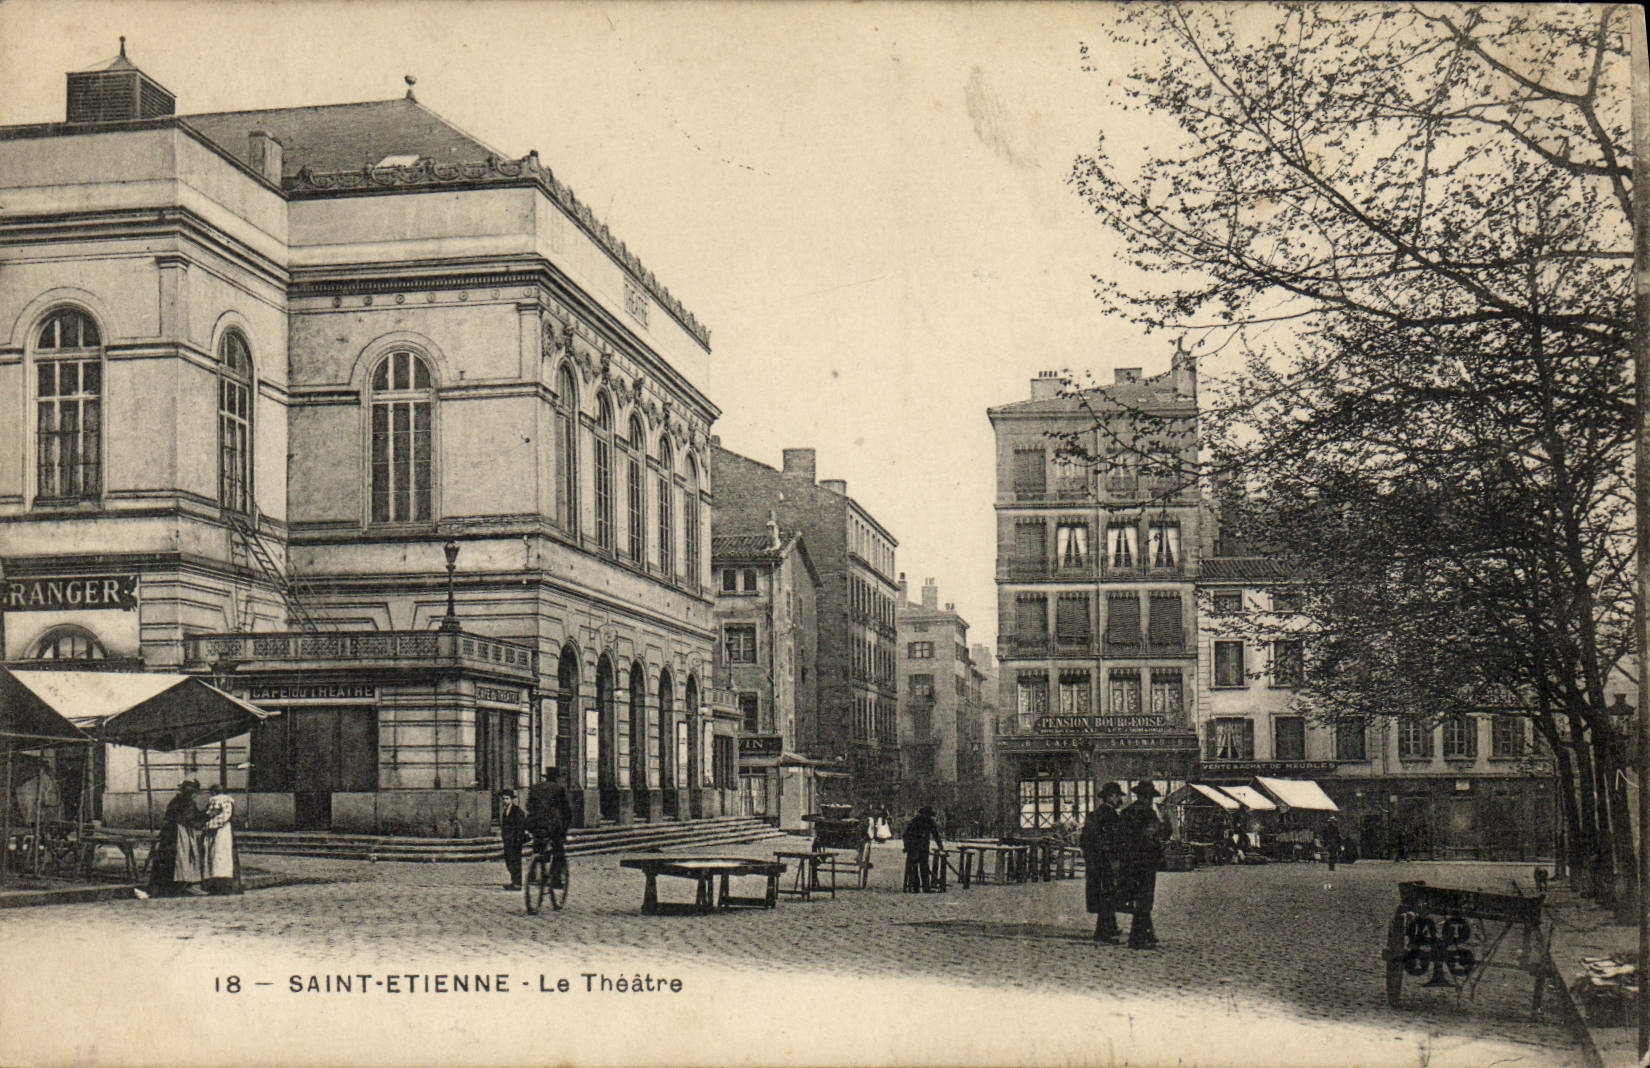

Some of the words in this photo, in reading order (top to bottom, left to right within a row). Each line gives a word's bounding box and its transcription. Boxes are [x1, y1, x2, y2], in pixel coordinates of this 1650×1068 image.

[3, 580, 120, 606] RANGER
[1042, 717, 1089, 728] PENSION
[1095, 716, 1164, 727] BOURGEOISE
